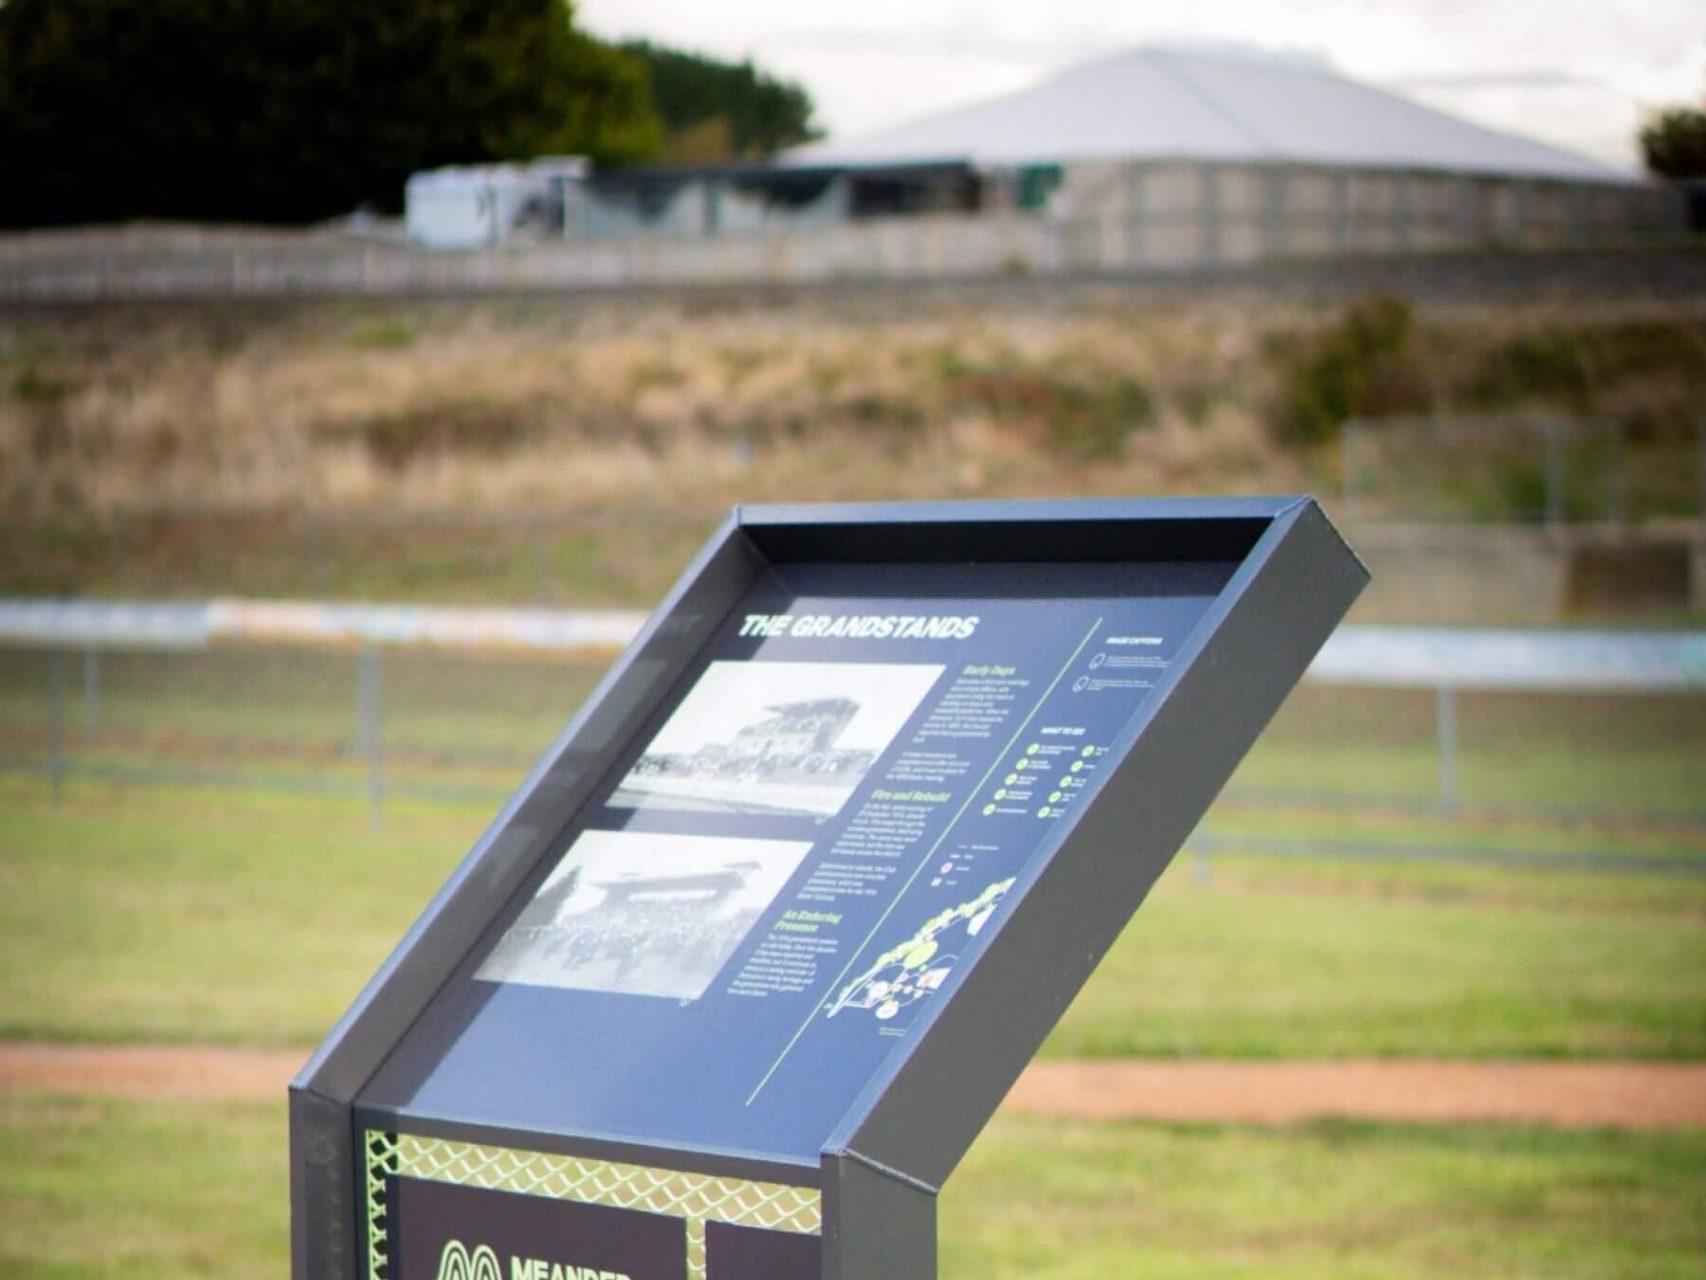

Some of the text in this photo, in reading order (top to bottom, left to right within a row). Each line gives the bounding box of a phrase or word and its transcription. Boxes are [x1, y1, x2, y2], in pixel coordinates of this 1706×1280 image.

[738, 614, 981, 639] THE GRANDSTANDS
[963, 664, 1017, 677] Early Days
[871, 788, 952, 803] Fire and Rebuild
[781, 909, 843, 926] An Enduring
[774, 919, 819, 933] Presence
